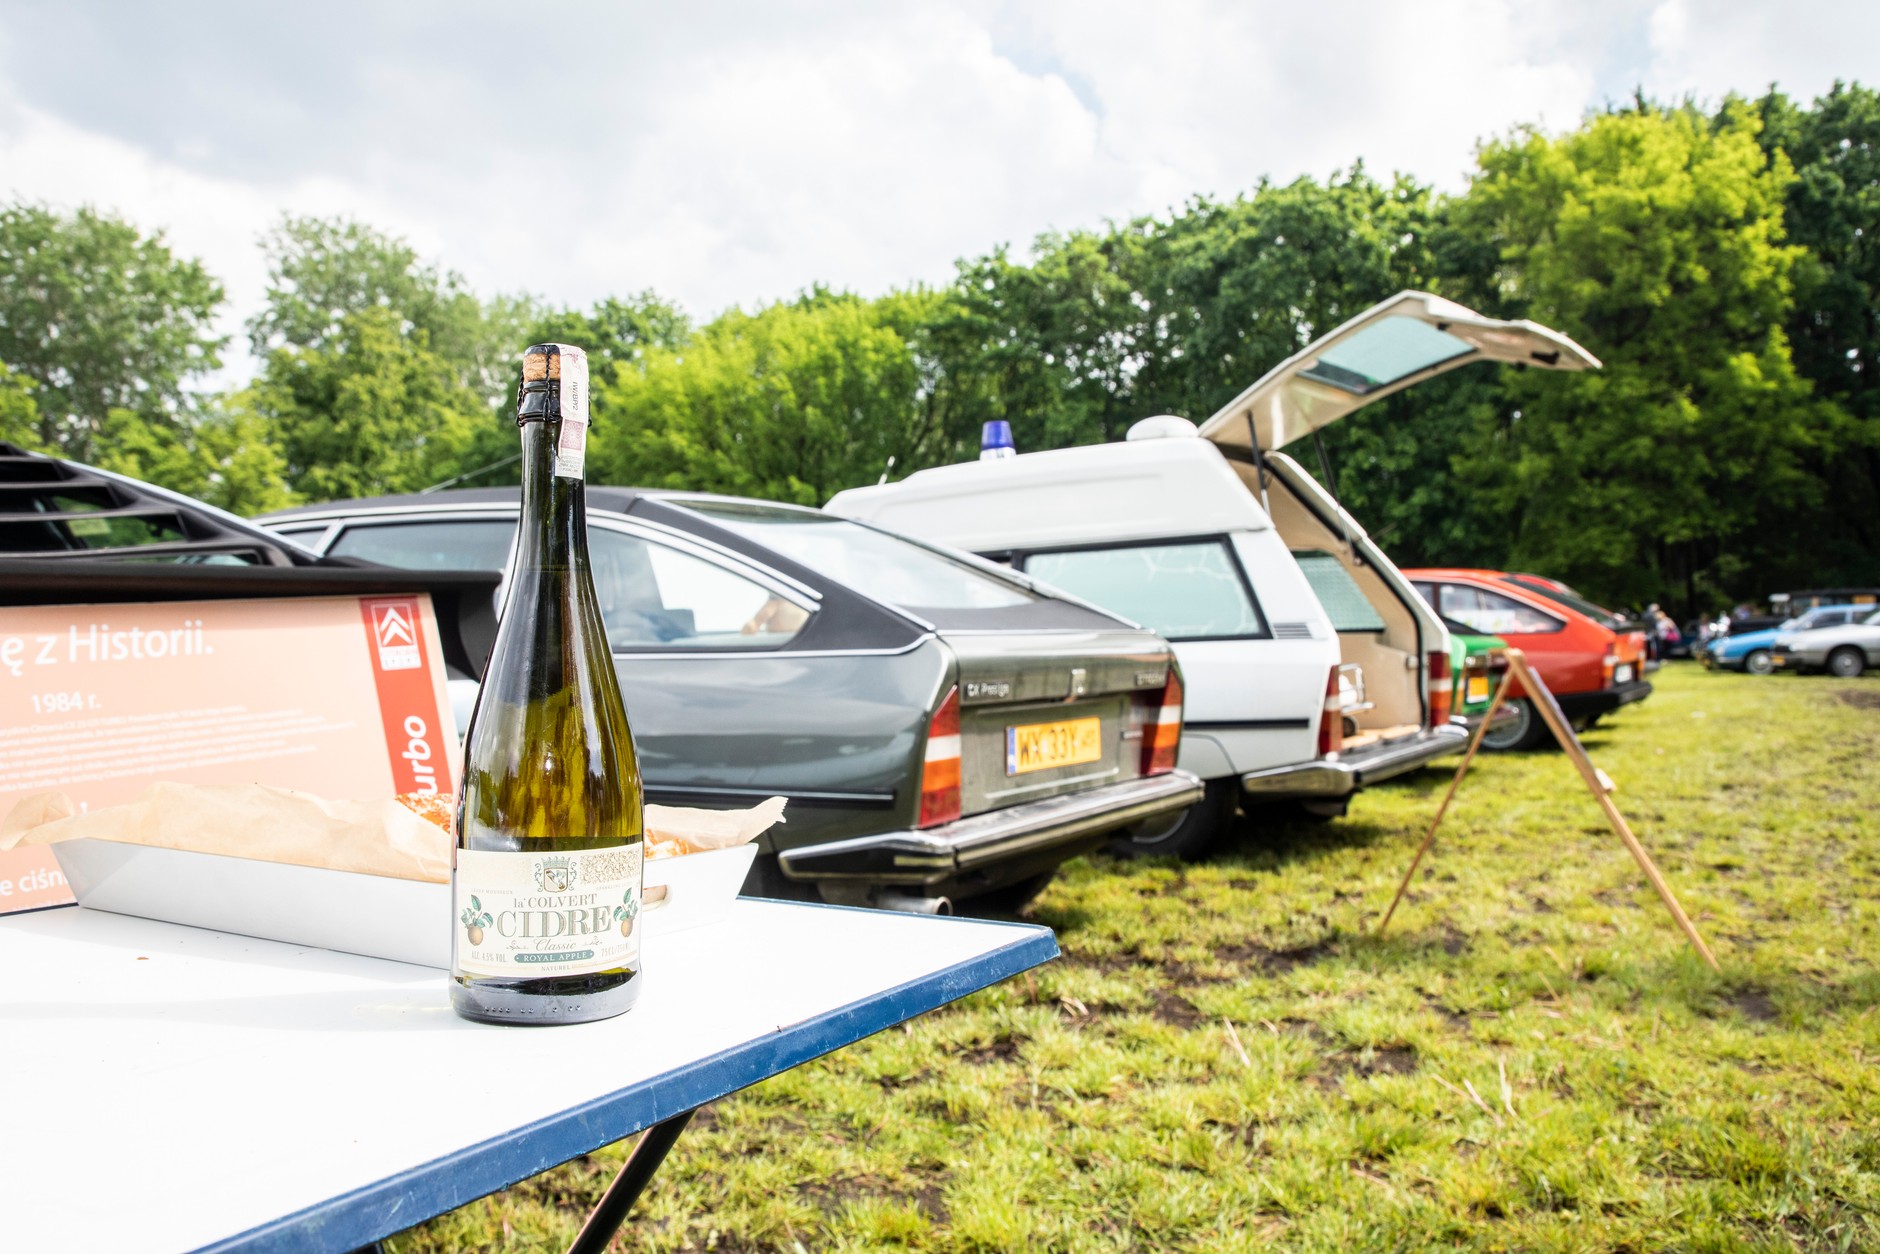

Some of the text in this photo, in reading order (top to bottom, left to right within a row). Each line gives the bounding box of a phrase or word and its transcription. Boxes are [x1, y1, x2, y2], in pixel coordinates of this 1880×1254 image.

[34, 635, 58, 665] z
[68, 619, 215, 663] Historii.
[31, 692, 103, 714] 1984 r.
[1018, 730, 1043, 766] WX
[496, 905, 612, 938] CIDRE
[523, 951, 587, 963] ROYAL APPLE
[533, 938, 577, 952] Classic
